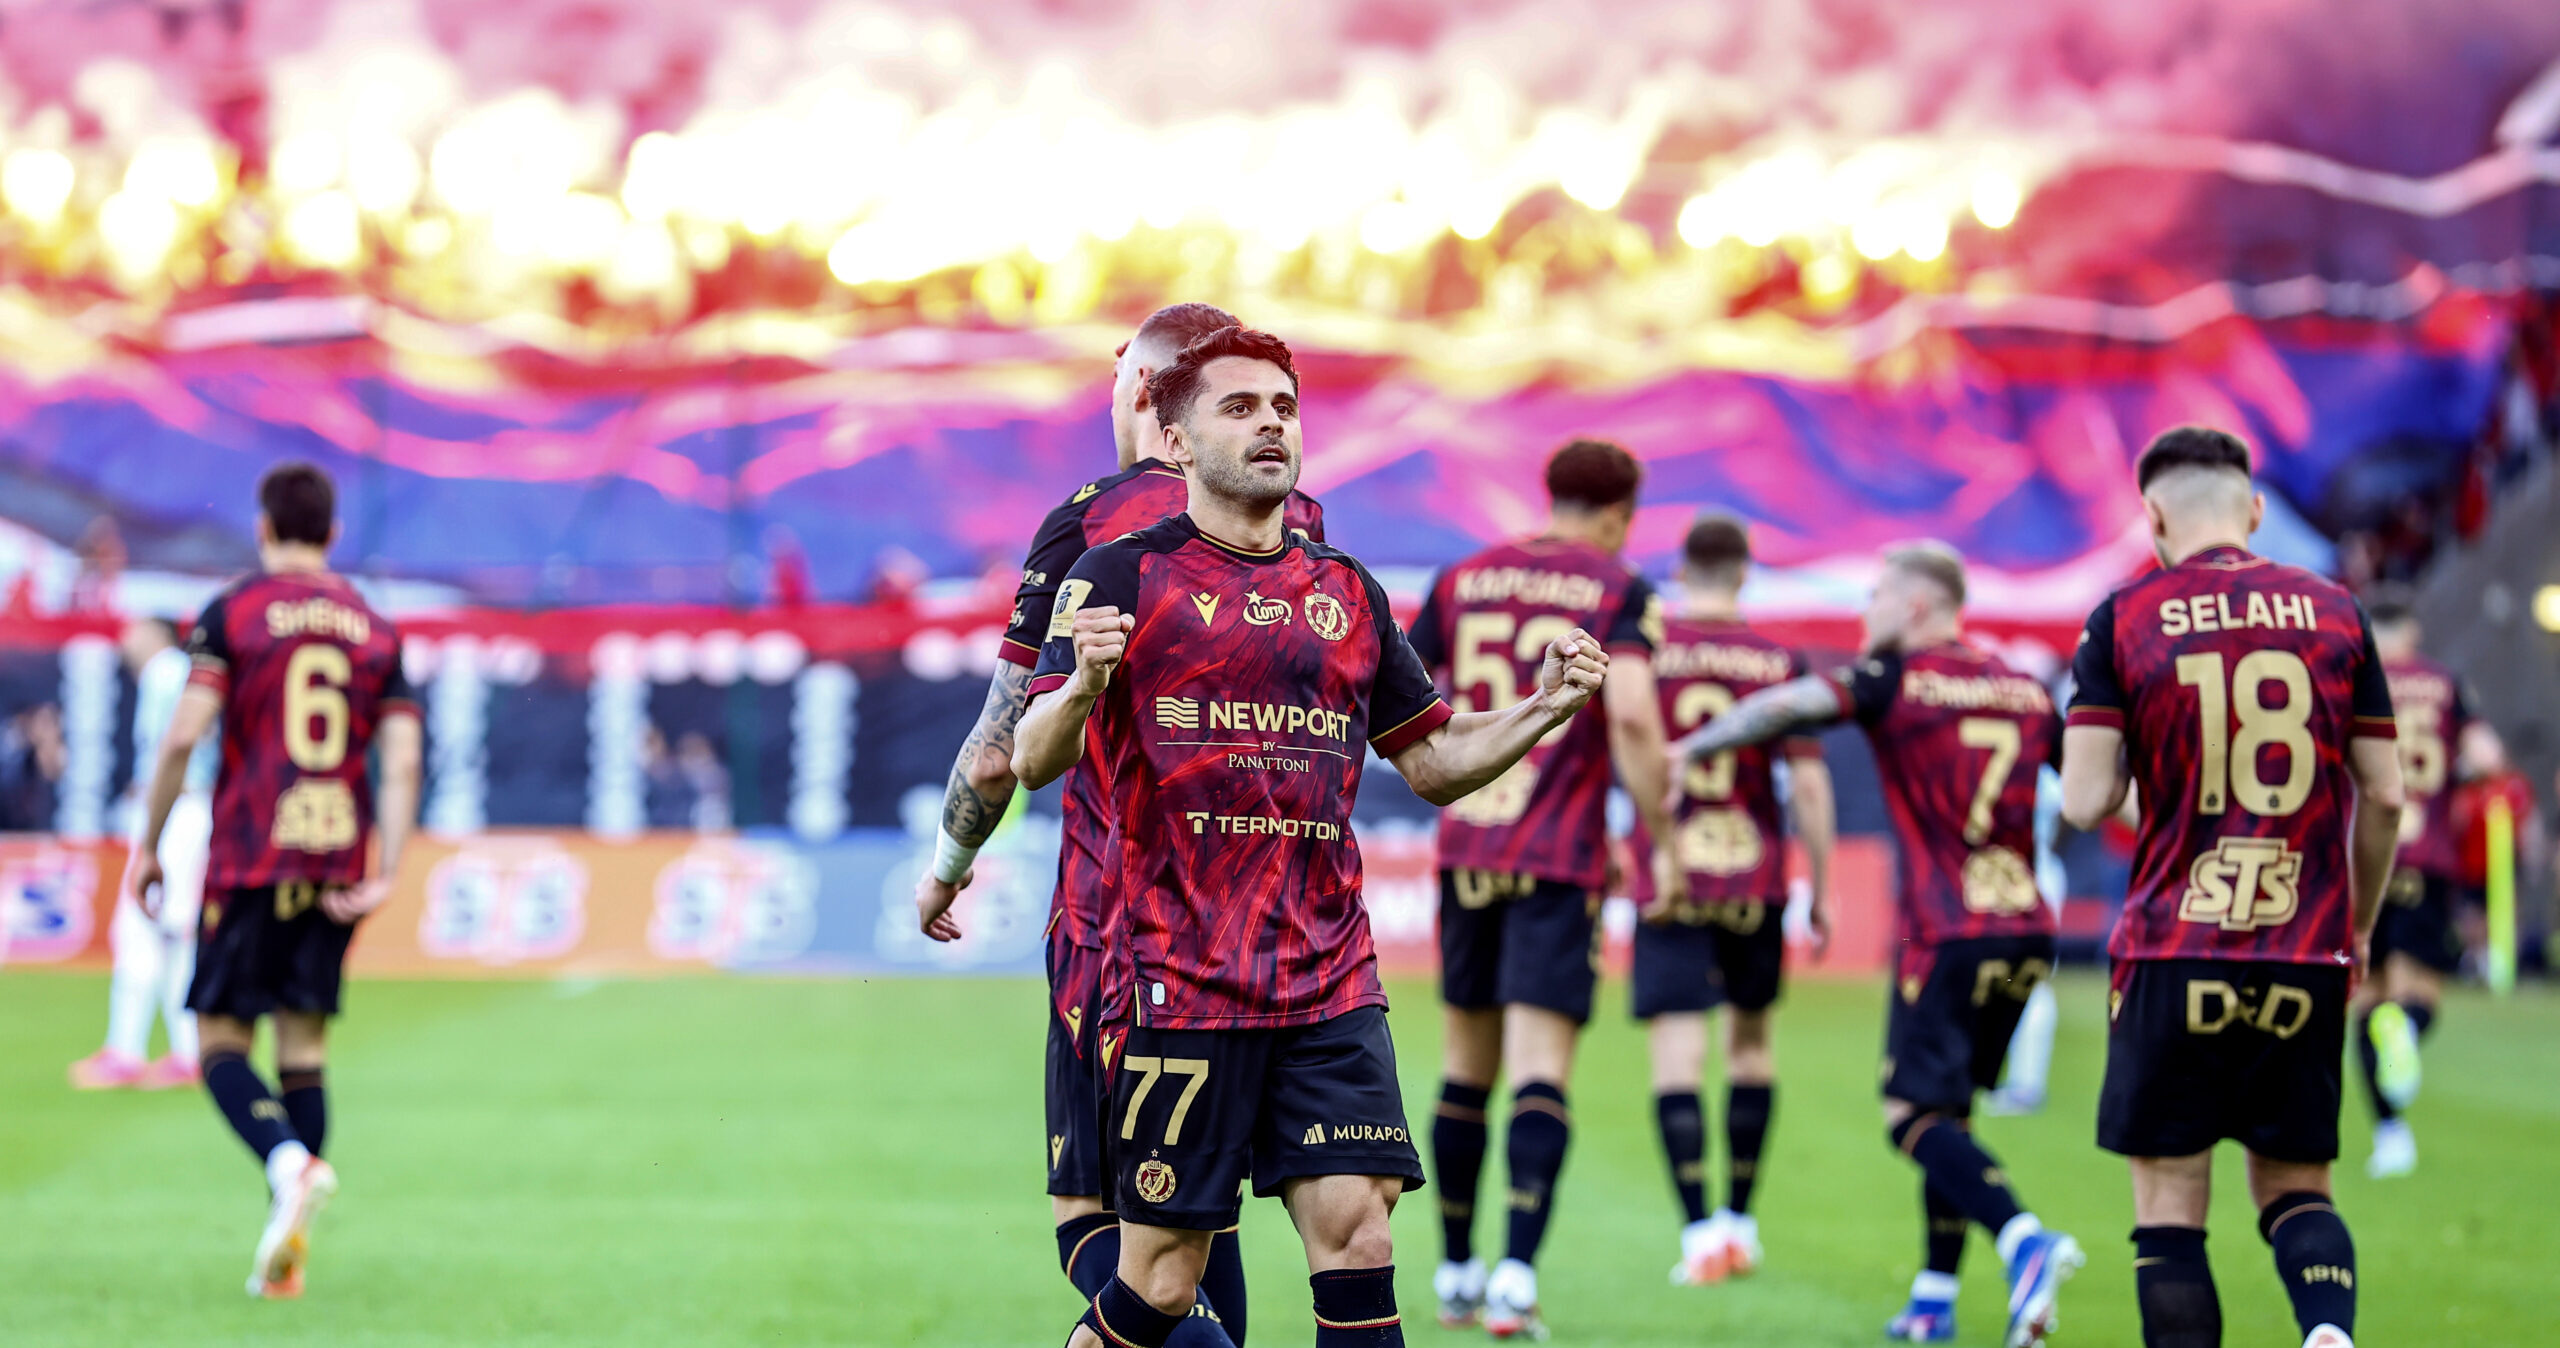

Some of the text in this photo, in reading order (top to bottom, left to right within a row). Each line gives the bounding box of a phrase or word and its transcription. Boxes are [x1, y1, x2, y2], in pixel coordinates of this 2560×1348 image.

[1253, 604, 1285, 620] LOTTO
[2159, 591, 2318, 636] SELAHI
[285, 644, 350, 770] 6
[1209, 700, 1350, 742] NEWPORT
[2175, 650, 2316, 816] 18
[1228, 753, 1310, 773] PANATTONI
[1262, 741, 1276, 752] BY
[1958, 716, 2021, 845] 7
[2178, 837, 2303, 931] STS
[2187, 979, 2313, 1040] D&D
[1121, 1054, 1209, 1145] 77
[1333, 1125, 1409, 1143] MURAPOL
